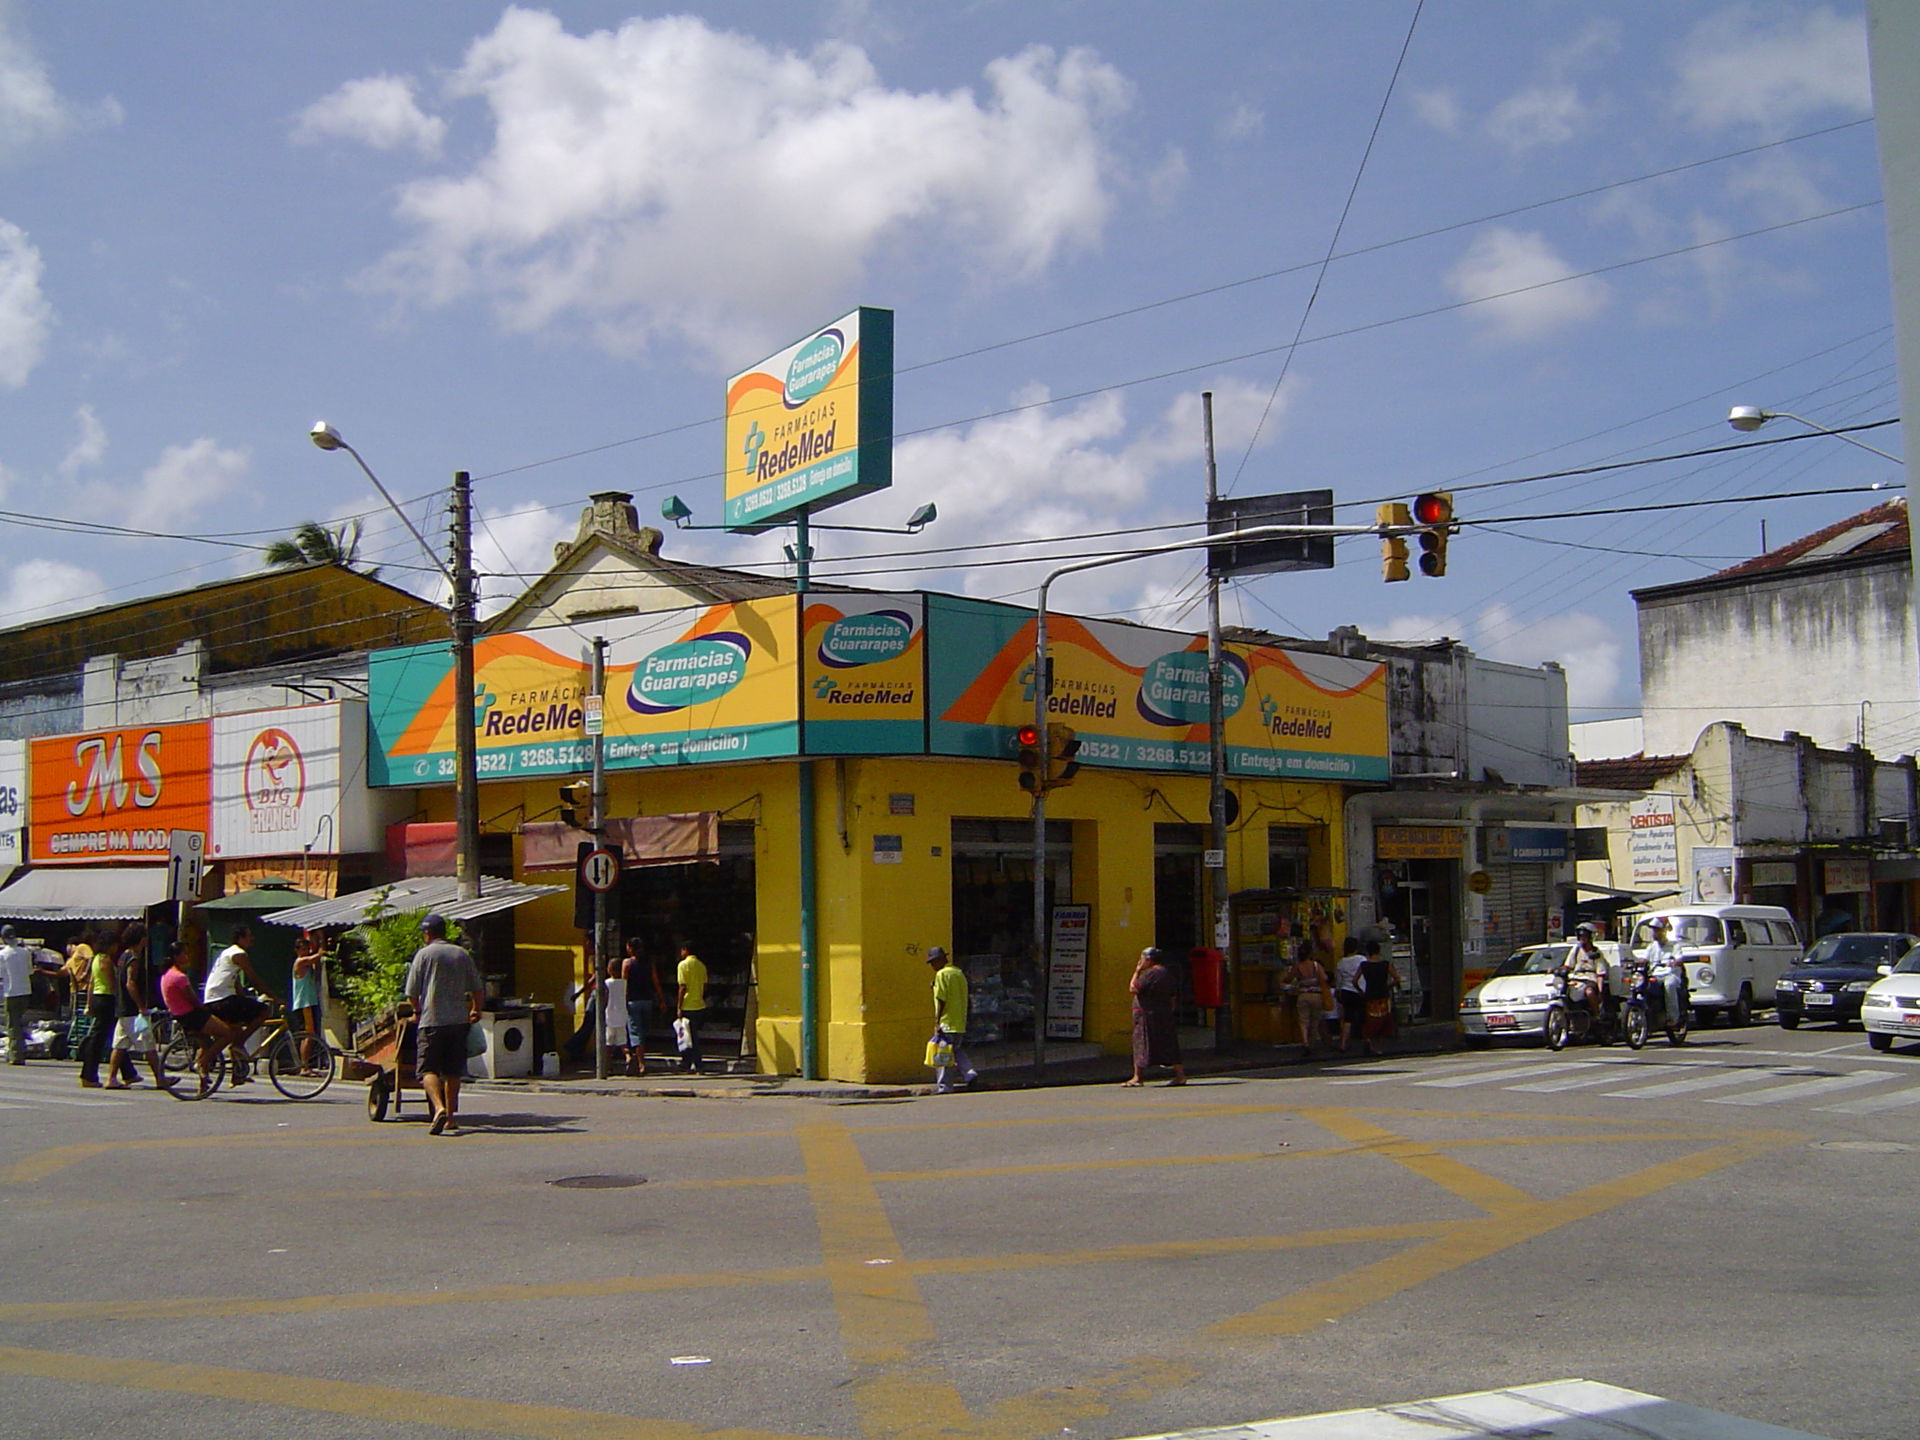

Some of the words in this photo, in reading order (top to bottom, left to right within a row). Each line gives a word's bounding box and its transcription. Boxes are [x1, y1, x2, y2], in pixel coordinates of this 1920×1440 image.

[792, 344, 836, 375] Farmácias
[789, 360, 837, 393] Guararapes
[774, 401, 835, 441] FARMÁCIAS
[757, 420, 837, 483] RedeMed
[833, 623, 901, 637] Farmácias
[829, 637, 905, 653] Guararapes
[645, 650, 734, 673] Farmácias
[641, 668, 739, 693] Guararapes
[848, 680, 913, 690] FARMÁCIAS
[1054, 678, 1116, 695] FARMÁCIAS
[828, 690, 914, 704] RedeMed
[1046, 692, 1117, 719] edeMed
[1151, 682, 1240, 708] Guararaes
[485, 703, 586, 737] RedeMe
[1285, 705, 1331, 719] FARMÁCIAS
[1272, 717, 1332, 739] RedeMed
[521, 744, 593, 768] 3268.5128
[609, 742, 656, 760] Entrega
[661, 740, 680, 755] em
[682, 734, 740, 754] domicílio
[1240, 753, 1282, 771] Entrega
[1286, 757, 1302, 769] em
[1304, 757, 1350, 773] domicílio
[258, 787, 292, 805] BIG
[250, 807, 299, 834] FRANGO
[1630, 814, 1674, 829] DENTISTA
[52, 831, 107, 853] SEMPRE
[109, 830, 129, 850] NA
